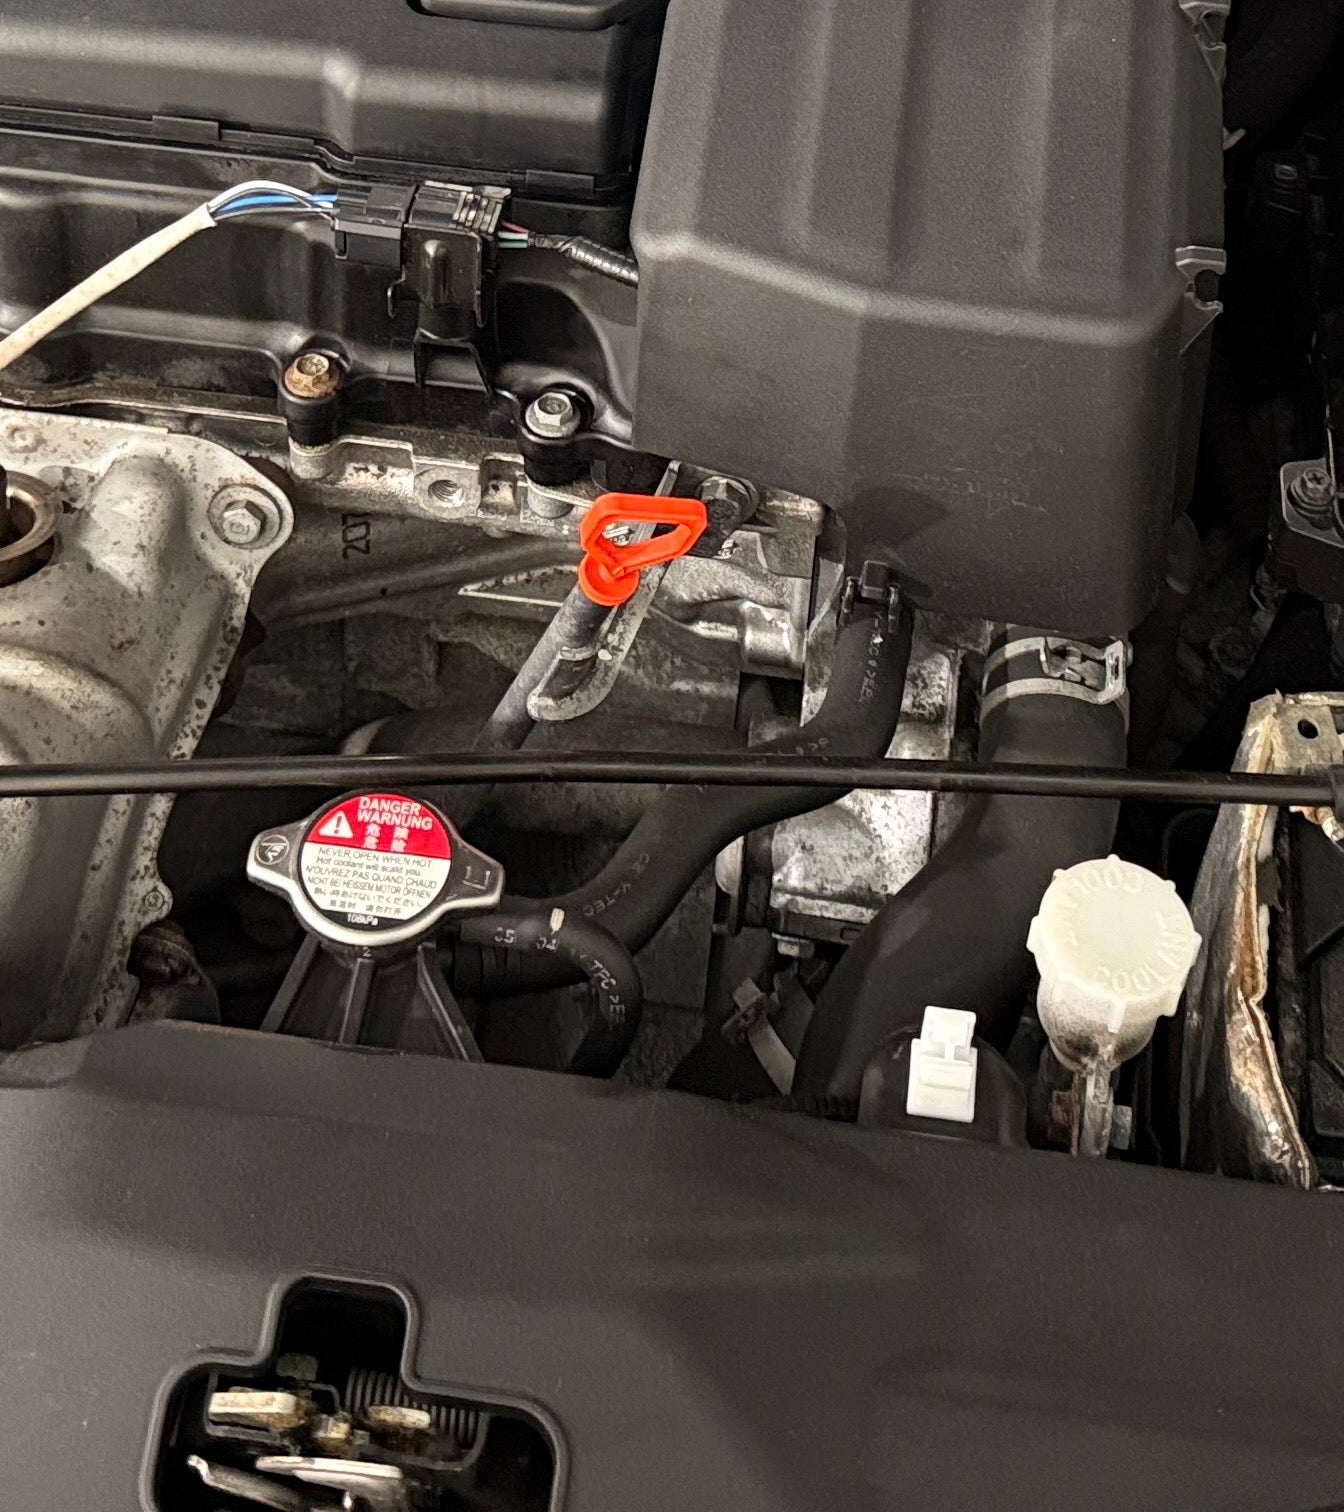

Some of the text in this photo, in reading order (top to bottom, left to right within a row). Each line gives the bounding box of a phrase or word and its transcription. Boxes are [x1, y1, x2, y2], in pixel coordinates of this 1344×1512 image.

[358, 796, 422, 816] DANGER
[357, 809, 434, 831] WARNUNG
[316, 856, 333, 865] Hot
[333, 857, 365, 869] coolant
[319, 846, 433, 869] NEVER OPEN WHEN HOT
[351, 869, 370, 881] PAS
[371, 872, 405, 885] QUAND
[406, 877, 437, 890] CHAUD
